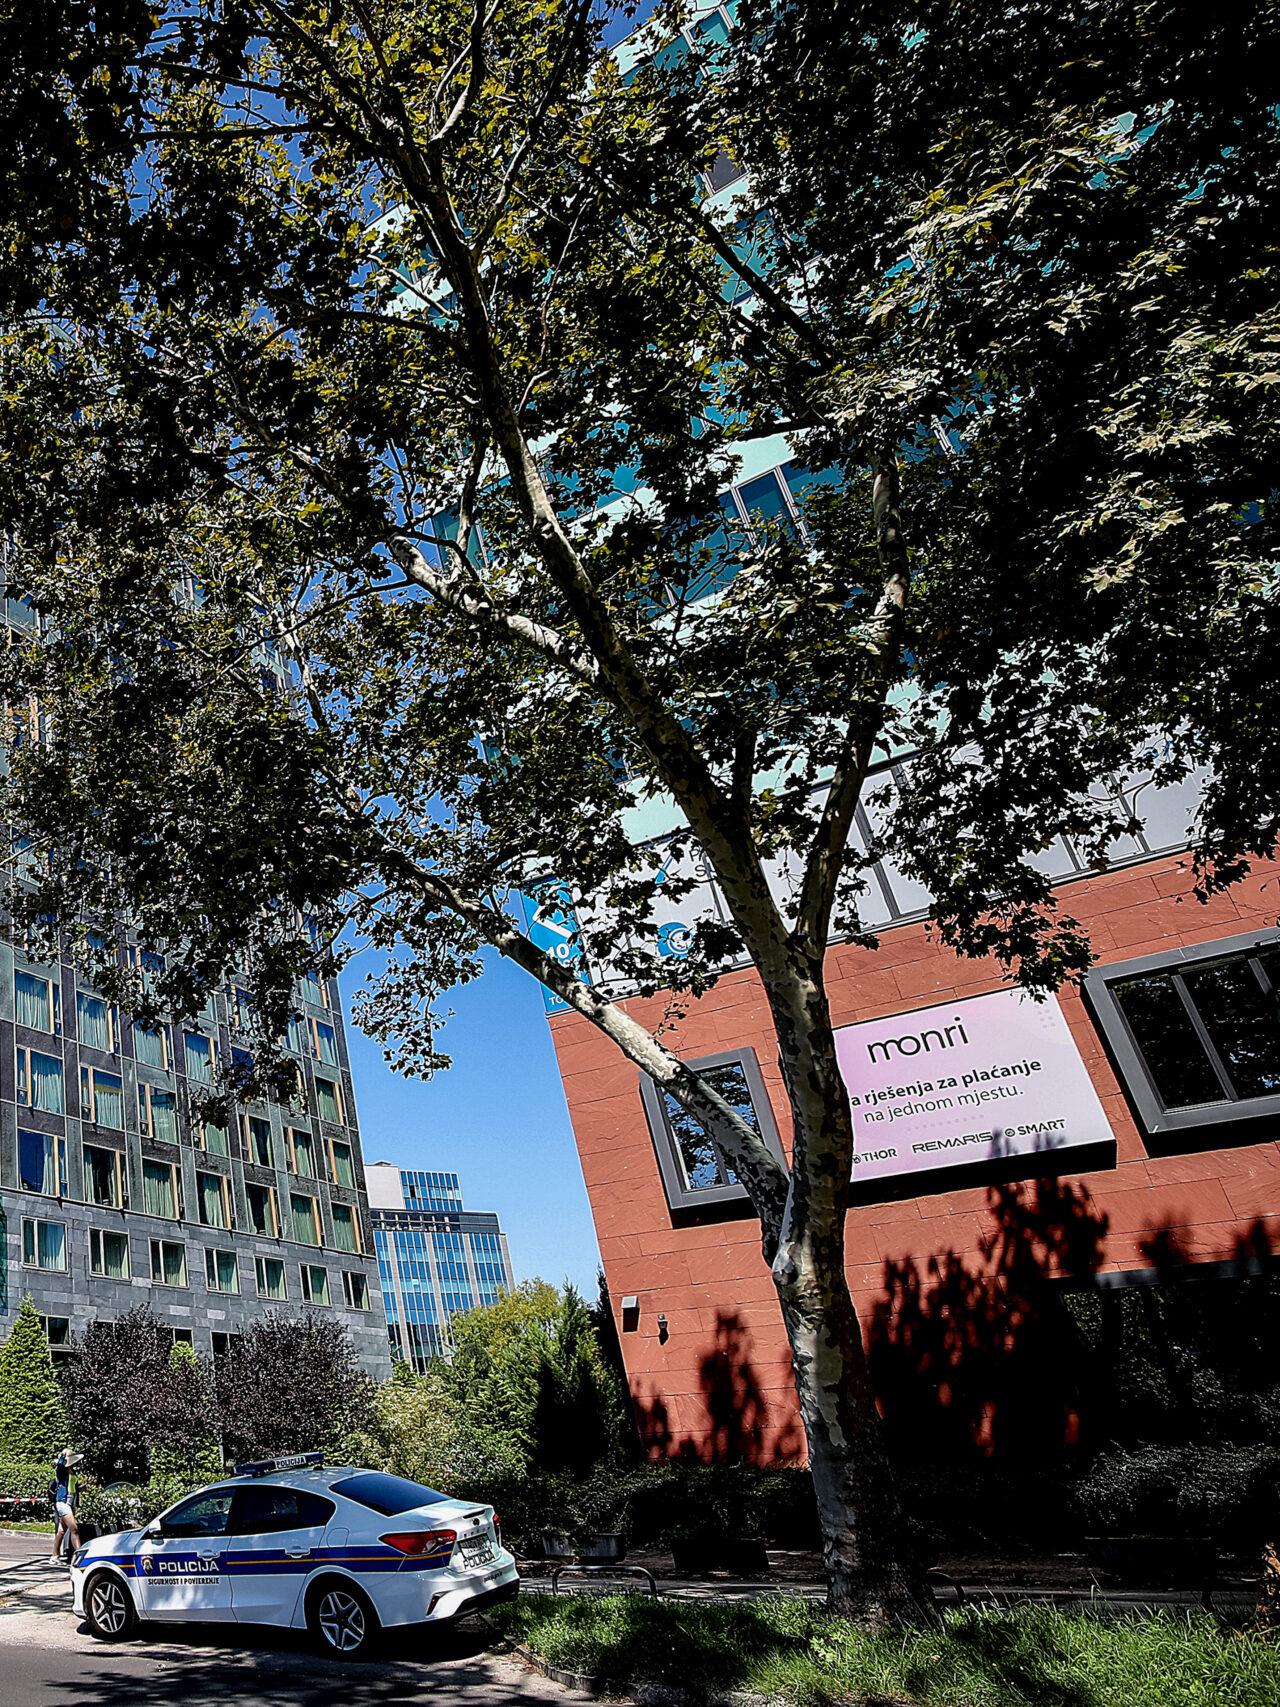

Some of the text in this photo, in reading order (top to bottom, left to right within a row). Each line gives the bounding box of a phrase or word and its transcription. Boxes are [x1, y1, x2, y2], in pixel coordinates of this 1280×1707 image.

[867, 1016, 969, 1064] monri
[864, 1080, 934, 1106] rješenja
[936, 1077, 958, 1090] za
[961, 1059, 1042, 1088] plaćanje
[863, 1085, 1024, 1123] na jednom mjestu.
[861, 1118, 1065, 1162] THOR REMARIS SMART
[276, 1457, 306, 1467] POLICIJA
[158, 1560, 220, 1573] POLICIJA
[463, 1549, 496, 1570] POLICIJA
[148, 1578, 180, 1586] SIGURNOST
